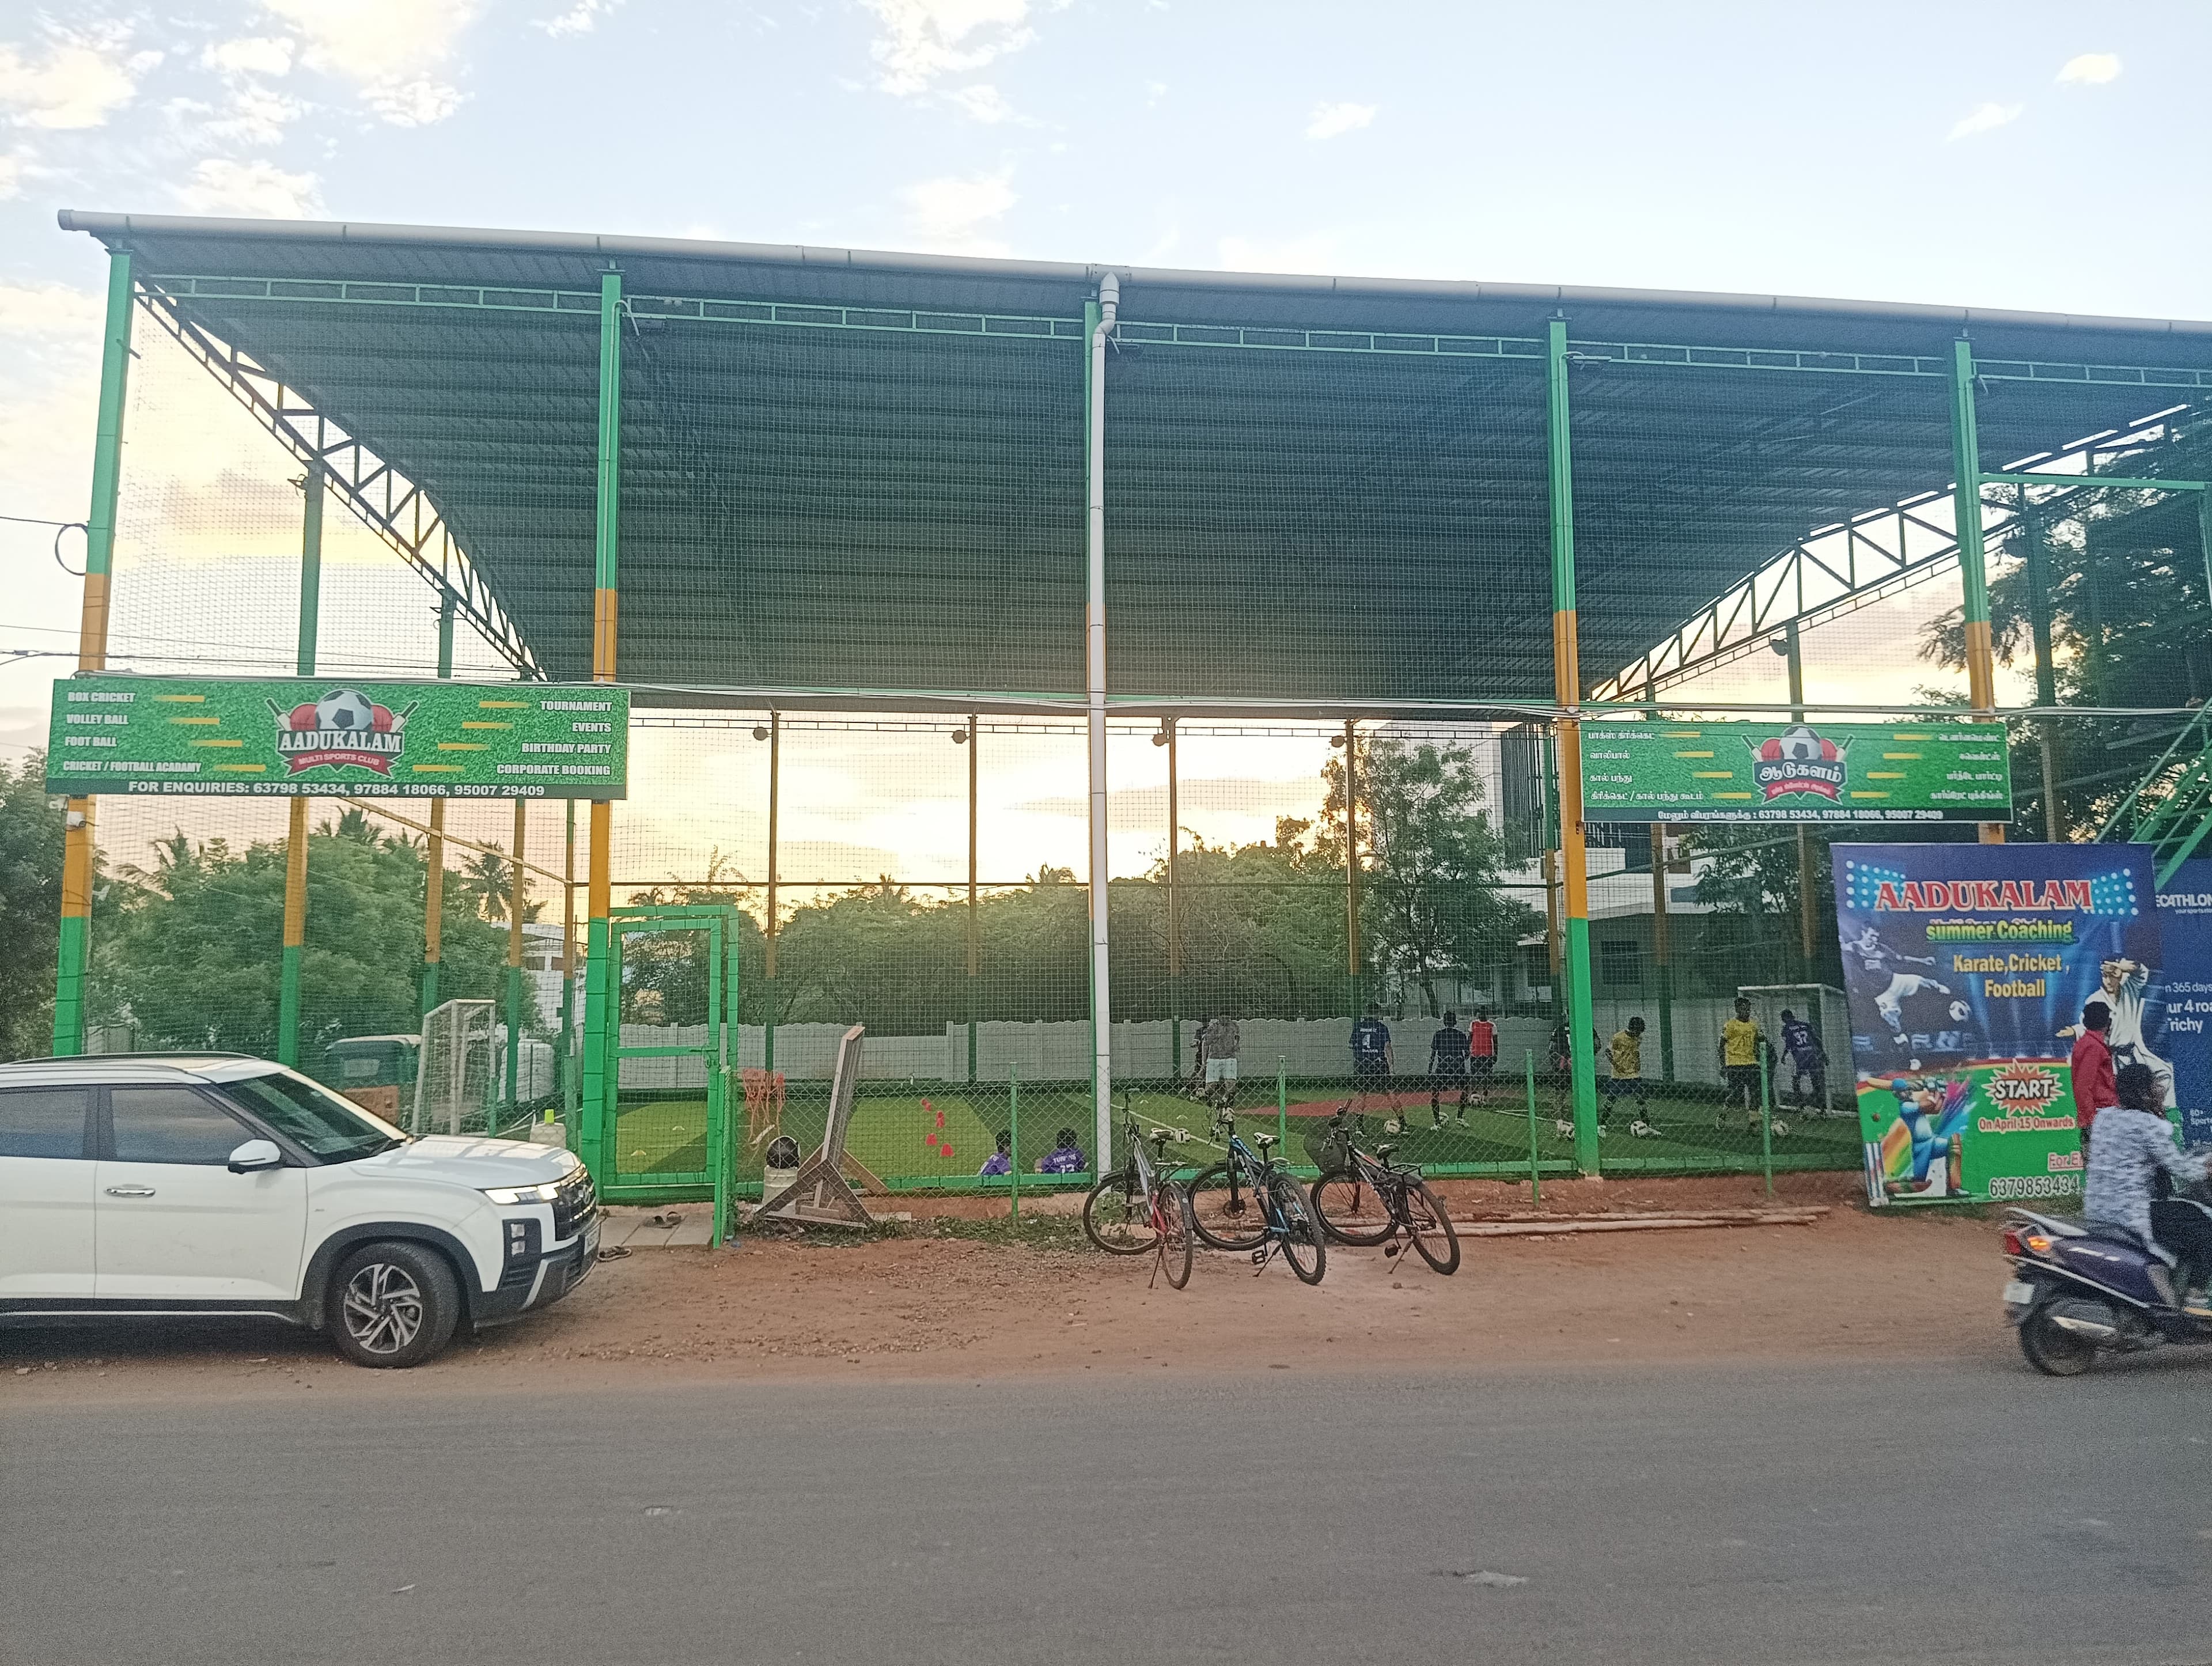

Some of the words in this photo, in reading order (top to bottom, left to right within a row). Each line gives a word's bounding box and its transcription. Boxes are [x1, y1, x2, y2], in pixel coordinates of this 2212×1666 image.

[68, 692, 89, 702] BOX
[90, 692, 136, 702] CRICKET
[540, 701, 612, 711] TOURNAMENT
[66, 714, 103, 724] VOLLEY
[104, 715, 129, 725] BALL
[572, 722, 612, 732] EVENTS
[65, 736, 92, 747] FOOT
[92, 737, 118, 747] BALL
[279, 730, 402, 753] AADUKALAM
[521, 743, 576, 753] BIRTHDAY
[577, 744, 612, 754] PARTY
[298, 754, 324, 765] MULTI
[324, 753, 357, 761] SPORTS
[357, 755, 380, 766] CLUB
[63, 760, 103, 771] CRICKET
[110, 762, 155, 772] FOOTBALL
[497, 764, 560, 775] CORPORATE
[561, 765, 611, 775] BOOKING
[1759, 761, 1842, 783] ஆடுகளம்
[1589, 773, 1609, 782] கால்
[1611, 773, 1633, 784] பந்து
[128, 781, 159, 792] FOR
[162, 781, 250, 793] ENQUIRIES:
[253, 782, 298, 794] 63798
[301, 783, 350, 796] 53434,
[354, 783, 399, 795] 97884
[403, 784, 450, 797] 18066,
[454, 785, 498, 796] 95007
[501, 785, 545, 796] 29409
[1635, 790, 1656, 800] கால்
[1657, 791, 1679, 801] பந்து
[1758, 810, 1787, 819] 63798
[1789, 810, 1821, 820] 53434,
[1876, 880, 2094, 911] AADUKALAM
[2156, 893, 2212, 907] ECATHLON
[1926, 923, 1995, 941] summer
[1997, 920, 2073, 942] Coaching
[1984, 979, 2046, 998] Football
[2172, 982, 2191, 993] 365
[2192, 982, 2212, 994] days
[2184, 999, 2195, 1013] 4
[2167, 1017, 2203, 1034] richy
[1994, 1079, 2054, 1100] START
[1979, 1119, 1993, 1130] On
[1995, 1118, 2017, 1133] April
[2020, 1118, 2032, 1130] 15
[2033, 1115, 2074, 1130] Onwards
